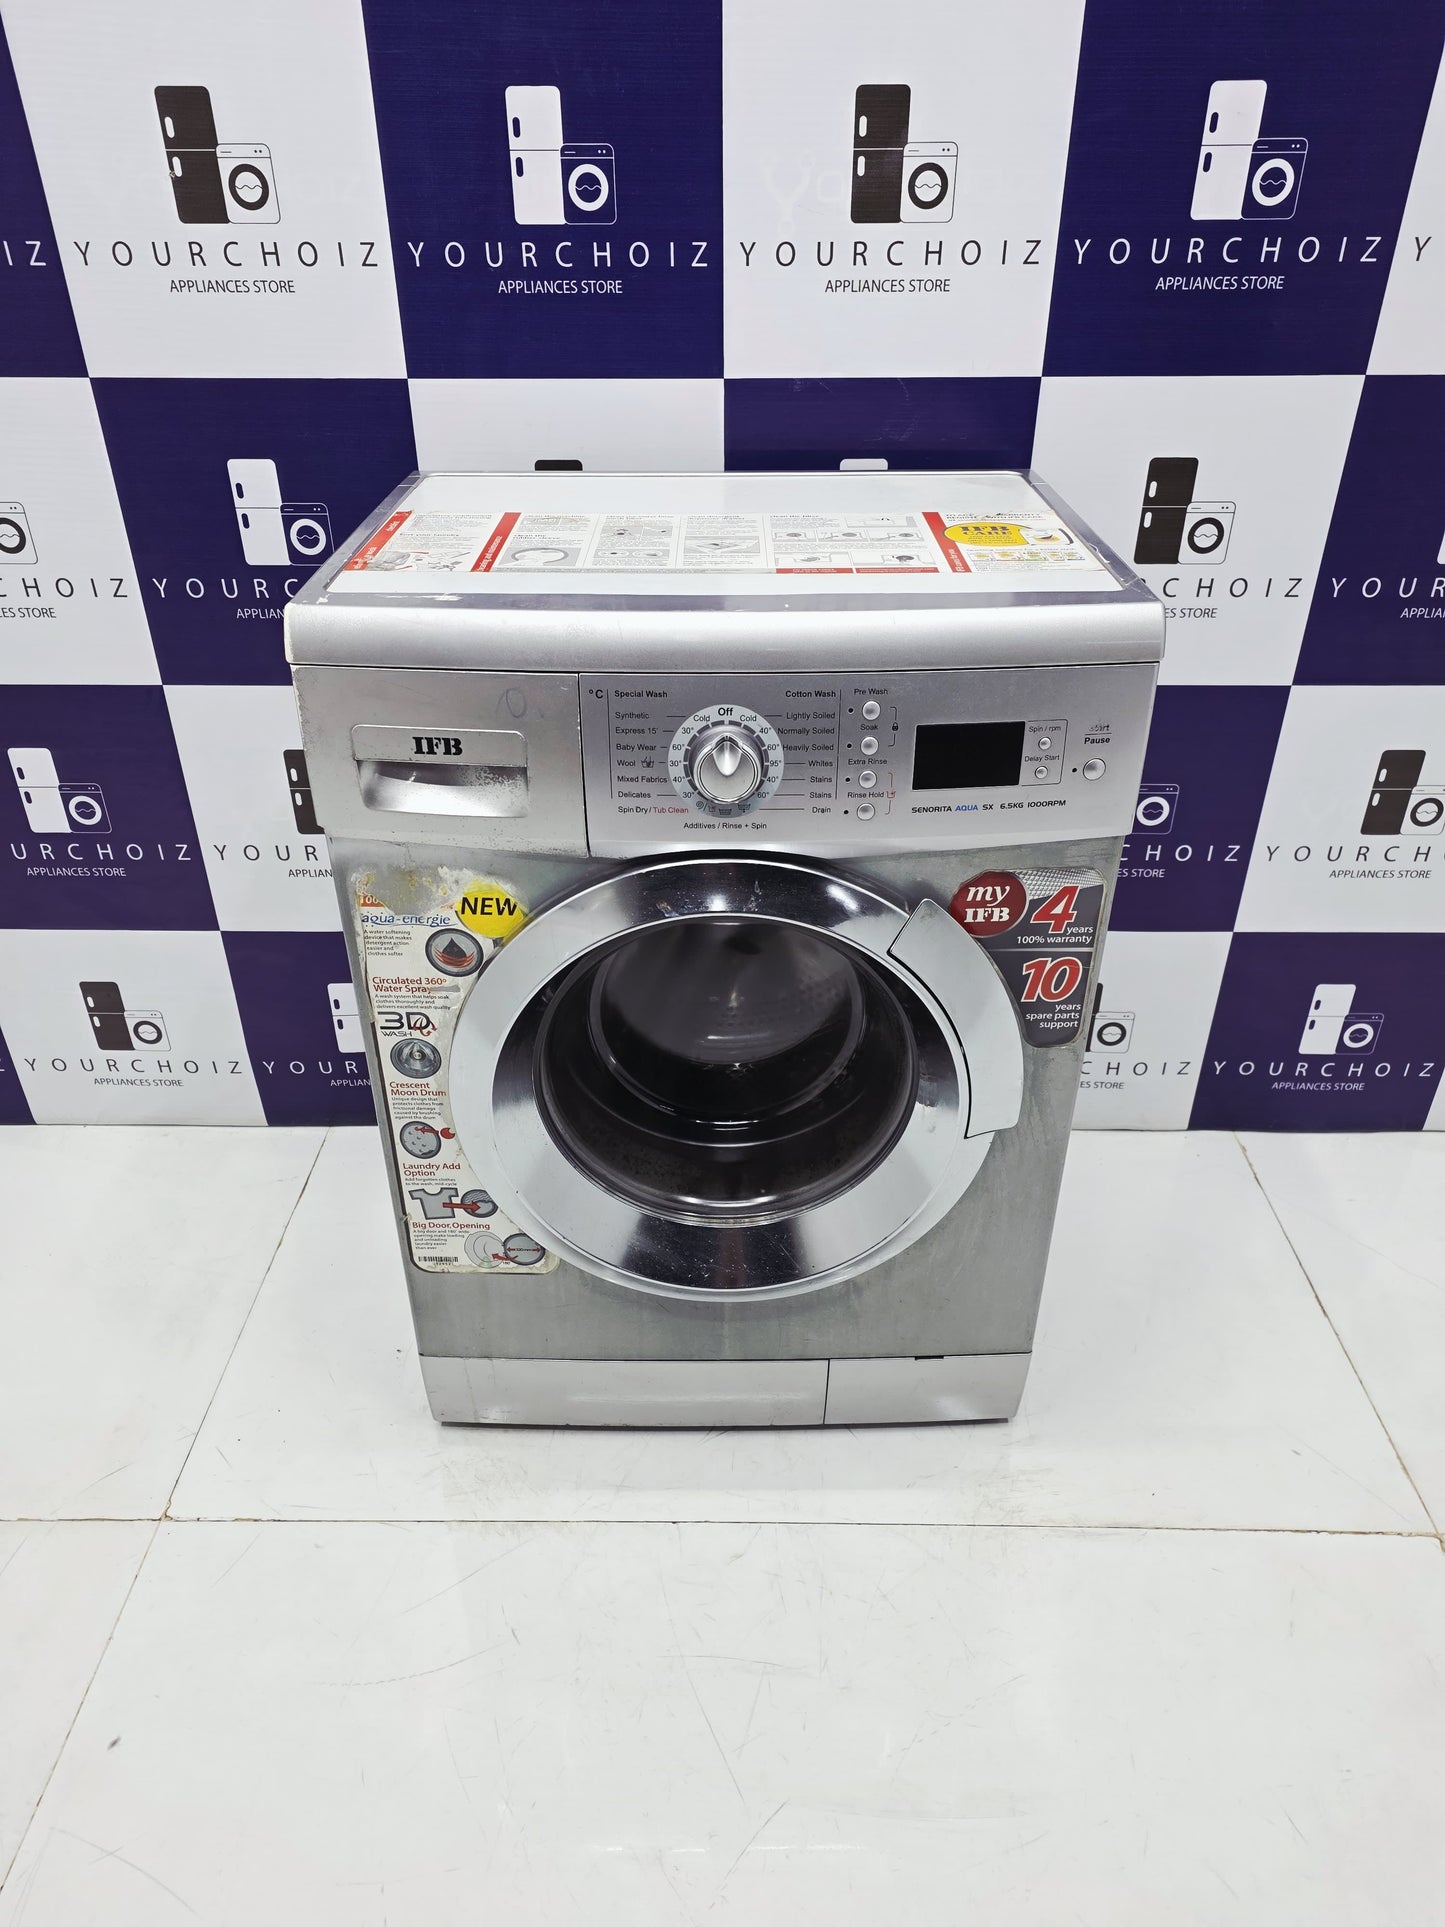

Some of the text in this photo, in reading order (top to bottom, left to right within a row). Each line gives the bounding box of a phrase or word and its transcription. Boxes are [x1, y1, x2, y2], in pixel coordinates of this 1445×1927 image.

[74, 240, 379, 267] YOURCHOIZ
[408, 241, 708, 268] YOURCHOIZ
[739, 239, 1042, 266] YOURCHOIZ
[1073, 236, 1382, 265] YOURCHOIZ
[170, 279, 296, 294] APPLIANCES STORE
[498, 280, 623, 294] APPLIANCES STORE
[825, 278, 951, 293] APPLIANCES STORE
[1155, 275, 1285, 290] APPLIANCES STORE
[18, 607, 57, 619] STORE
[1179, 607, 1218, 618] STORE
[1400, 607, 1445, 619] APPLIA
[614, 690, 668, 699] Special Wash
[785, 690, 837, 698] Cotton Wash
[615, 711, 650, 720] Synthetic
[717, 707, 734, 716] Off
[786, 711, 810, 720] Lightly
[693, 714, 711, 723] Cold
[739, 714, 757, 722] Cold
[615, 727, 646, 736] Express
[777, 727, 835, 736] Normally Soiled
[1028, 725, 1062, 734] Spin rpm
[1084, 737, 1111, 745] Pause
[412, 736, 463, 756] IFB
[616, 743, 636, 753] Baby
[783, 744, 809, 753] Heavily
[808, 759, 834, 767] Whites
[848, 758, 866, 766] Extra
[1024, 755, 1044, 763] Delay
[617, 775, 668, 783] Mixed Fabrics
[810, 775, 833, 783] Stains
[618, 791, 652, 799] Delicates
[809, 791, 832, 799] Stains
[847, 791, 867, 799] Rinse
[618, 806, 635, 815] Spin
[652, 806, 667, 814] Tub
[668, 806, 689, 814] Clean
[911, 805, 952, 813] SENORITA
[955, 804, 978, 812] AQUA
[982, 803, 994, 811] SX
[1000, 801, 1024, 810] 6.5KG
[683, 822, 767, 830] Additives Rinse Spin
[10, 843, 192, 860] URCHOIZ
[214, 844, 319, 861] YOUR
[27, 867, 127, 878] APPLIANCES STORE
[1131, 868, 1166, 878] STORE
[1328, 869, 1432, 879] APPLIANCES STORE
[966, 885, 1011, 907] my
[461, 897, 517, 916] NEW
[1030, 885, 1080, 934] 4
[964, 907, 1010, 923] IFB
[1066, 926, 1094, 936] years
[1017, 936, 1092, 945] 100% warranty
[372, 977, 424, 985] Circulated
[1021, 957, 1082, 1003] 10
[374, 985, 431, 994] Water Spray
[1055, 1003, 1081, 1012] years
[378, 1011, 431, 1030] 3D
[1025, 1012, 1080, 1021] spare parts
[1039, 1021, 1078, 1030] support
[24, 1058, 243, 1074] YOURCHOIZ
[262, 1060, 358, 1075] YOUR
[1214, 1060, 1435, 1077] YOURCHOIZ
[94, 1077, 184, 1088] APPLIANCES STORE
[390, 1081, 430, 1089] Crescent
[1093, 1081, 1125, 1089] STORE
[1271, 1082, 1366, 1092] APPLIANCES STORE
[420, 1089, 447, 1097] Drum
[403, 1163, 440, 1171] Laundry
[412, 1222, 427, 1230] Big
[452, 1222, 490, 1230] Opening
